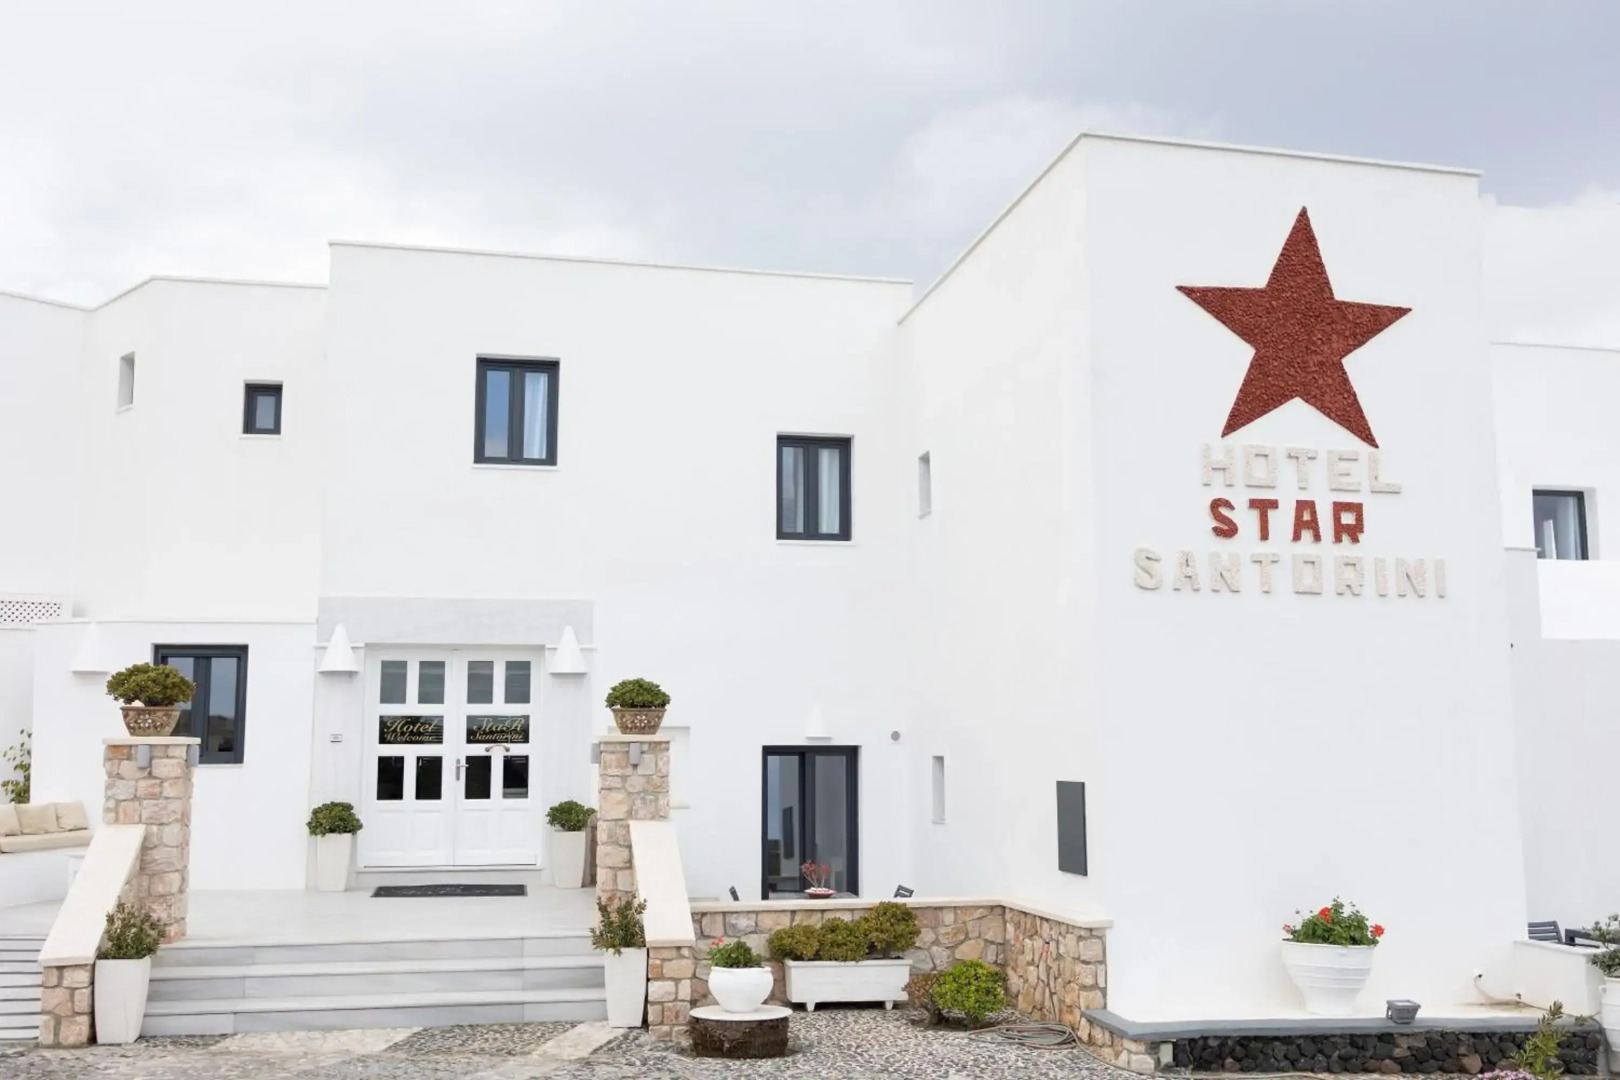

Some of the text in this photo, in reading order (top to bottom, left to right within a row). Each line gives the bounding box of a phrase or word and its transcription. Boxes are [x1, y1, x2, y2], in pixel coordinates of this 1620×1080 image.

[1202, 443, 1402, 494] HOTEL
[1210, 497, 1365, 543] STAR
[1134, 548, 1448, 598] SANTORINI
[384, 718, 439, 732] Hotel
[384, 731, 434, 741] Welcome
[470, 731, 525, 741] Santorini
